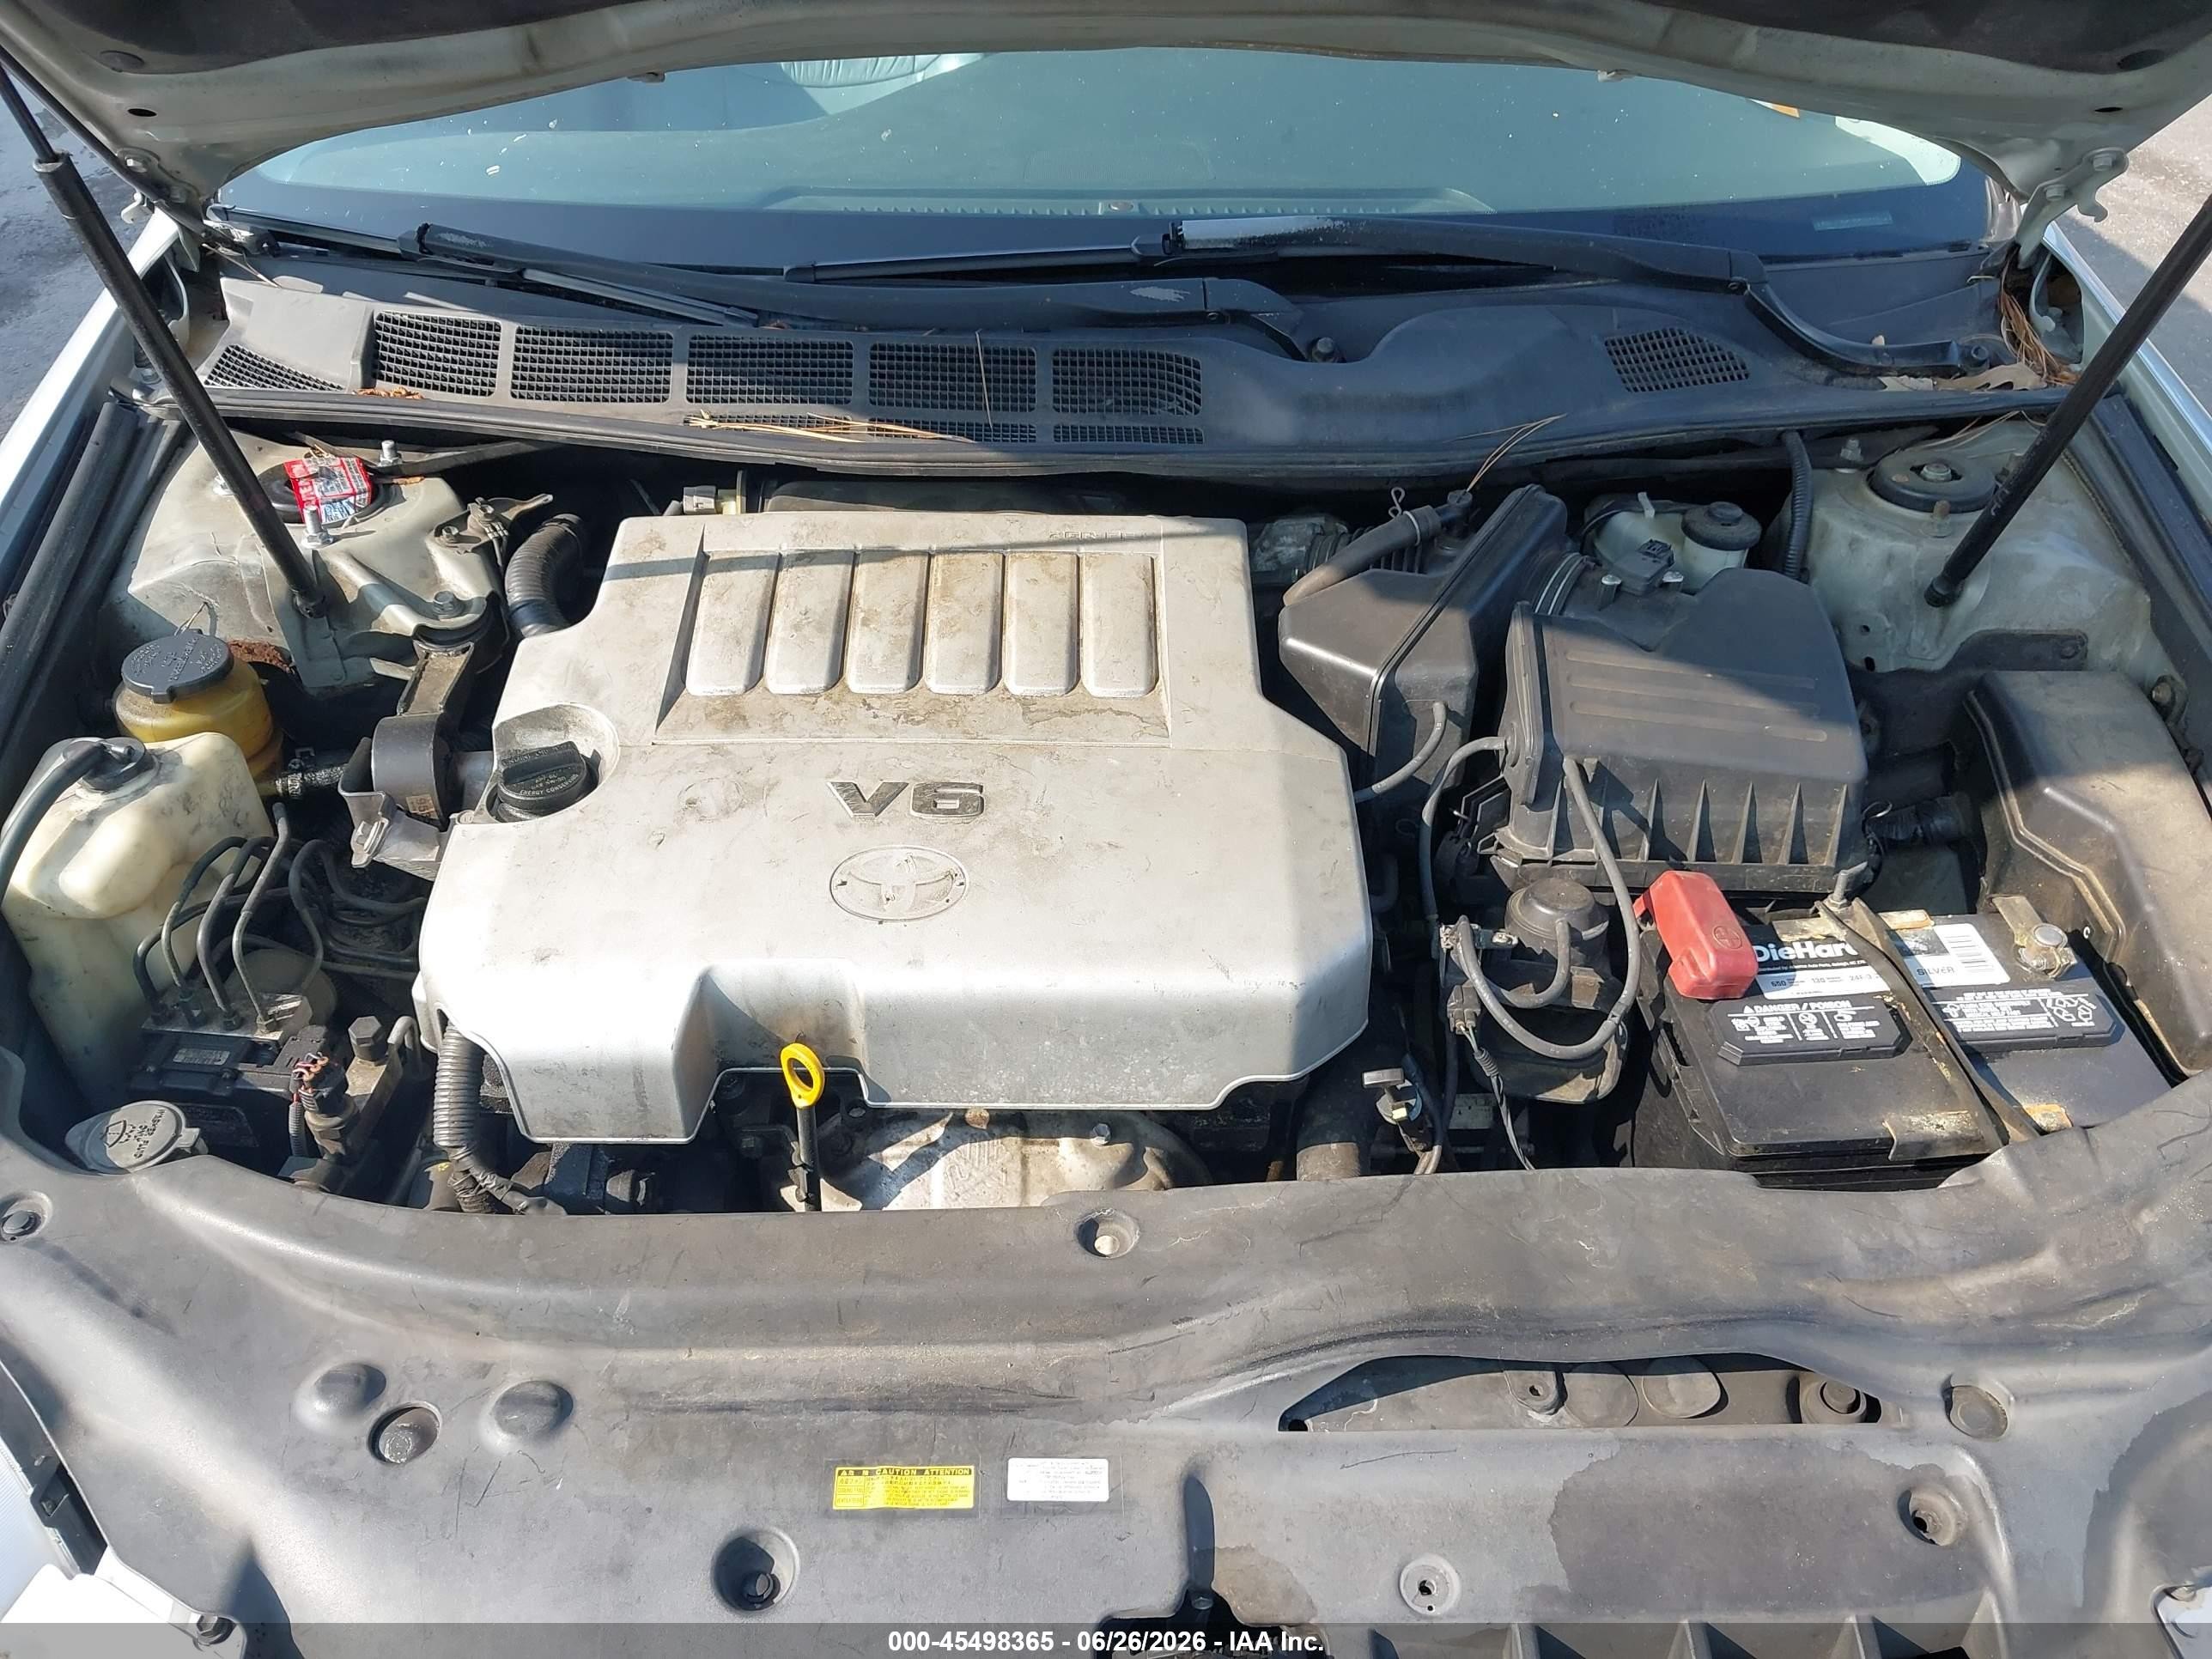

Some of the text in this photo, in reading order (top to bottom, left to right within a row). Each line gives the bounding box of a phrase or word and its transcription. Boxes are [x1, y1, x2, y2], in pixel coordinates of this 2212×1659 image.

[827, 781, 985, 817] V6
[1917, 966, 1955, 975] SILVER
[1754, 1000, 1851, 1013] DANGER / POISON
